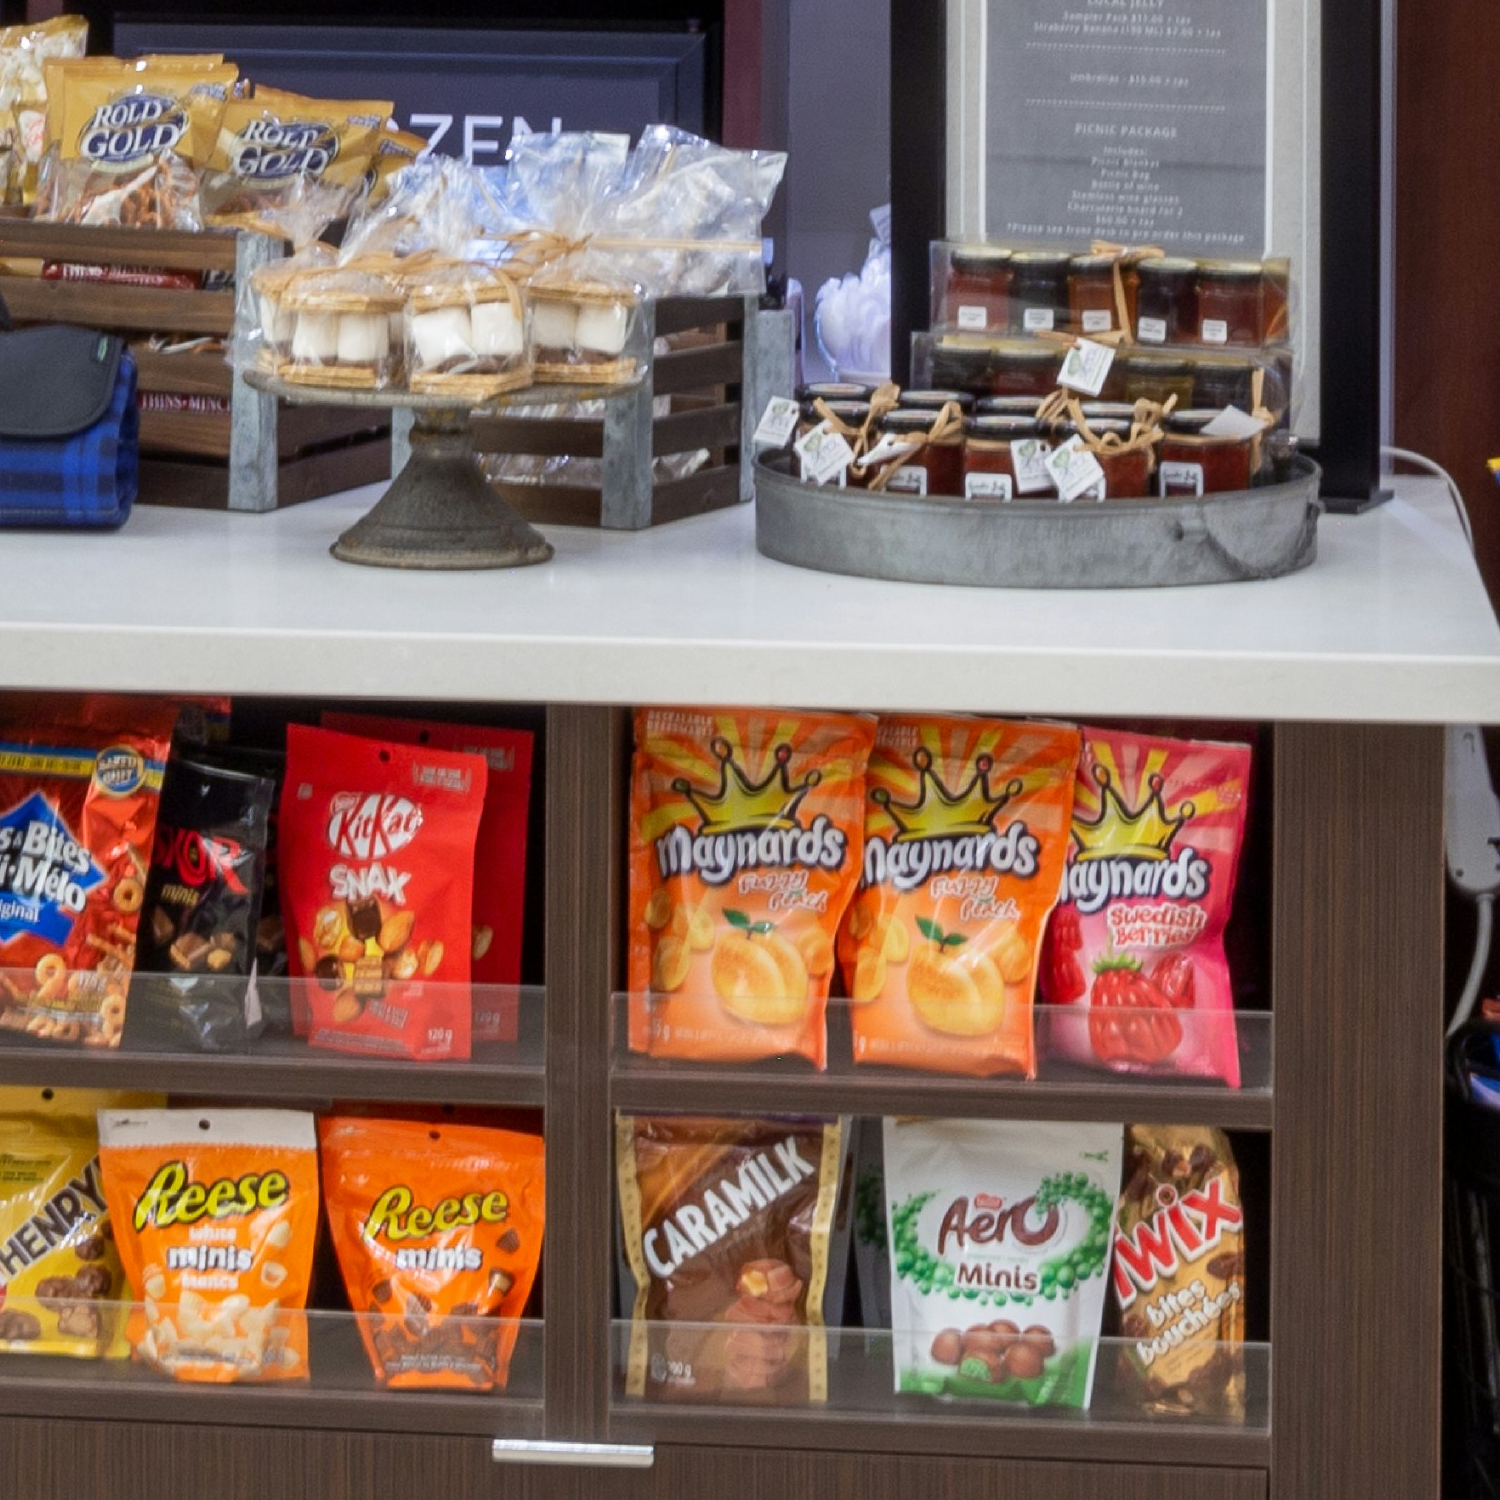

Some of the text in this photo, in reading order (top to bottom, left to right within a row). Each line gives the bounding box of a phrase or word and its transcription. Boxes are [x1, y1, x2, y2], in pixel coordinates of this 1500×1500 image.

[93, 102, 163, 130] ROLD
[241, 117, 318, 143] ROLD
[1075, 123, 1178, 138] PICNIC PACKAGE
[82, 122, 181, 158] GOLD
[234, 144, 332, 177] GOLD
[653, 815, 845, 884] Maynards
[329, 863, 413, 906] SNAX
[1061, 846, 1209, 913] aynards
[1106, 903, 1207, 930] Swedish
[134, 1160, 291, 1231] Reese
[642, 1134, 816, 1280] CARAMILK
[363, 1186, 509, 1242] Reese
[937, 1194, 1060, 1256] Aero
[166, 1244, 254, 1274] minis
[395, 1243, 485, 1271] minis
[954, 1261, 1040, 1292] Minis
[1145, 1280, 1206, 1326] bites
